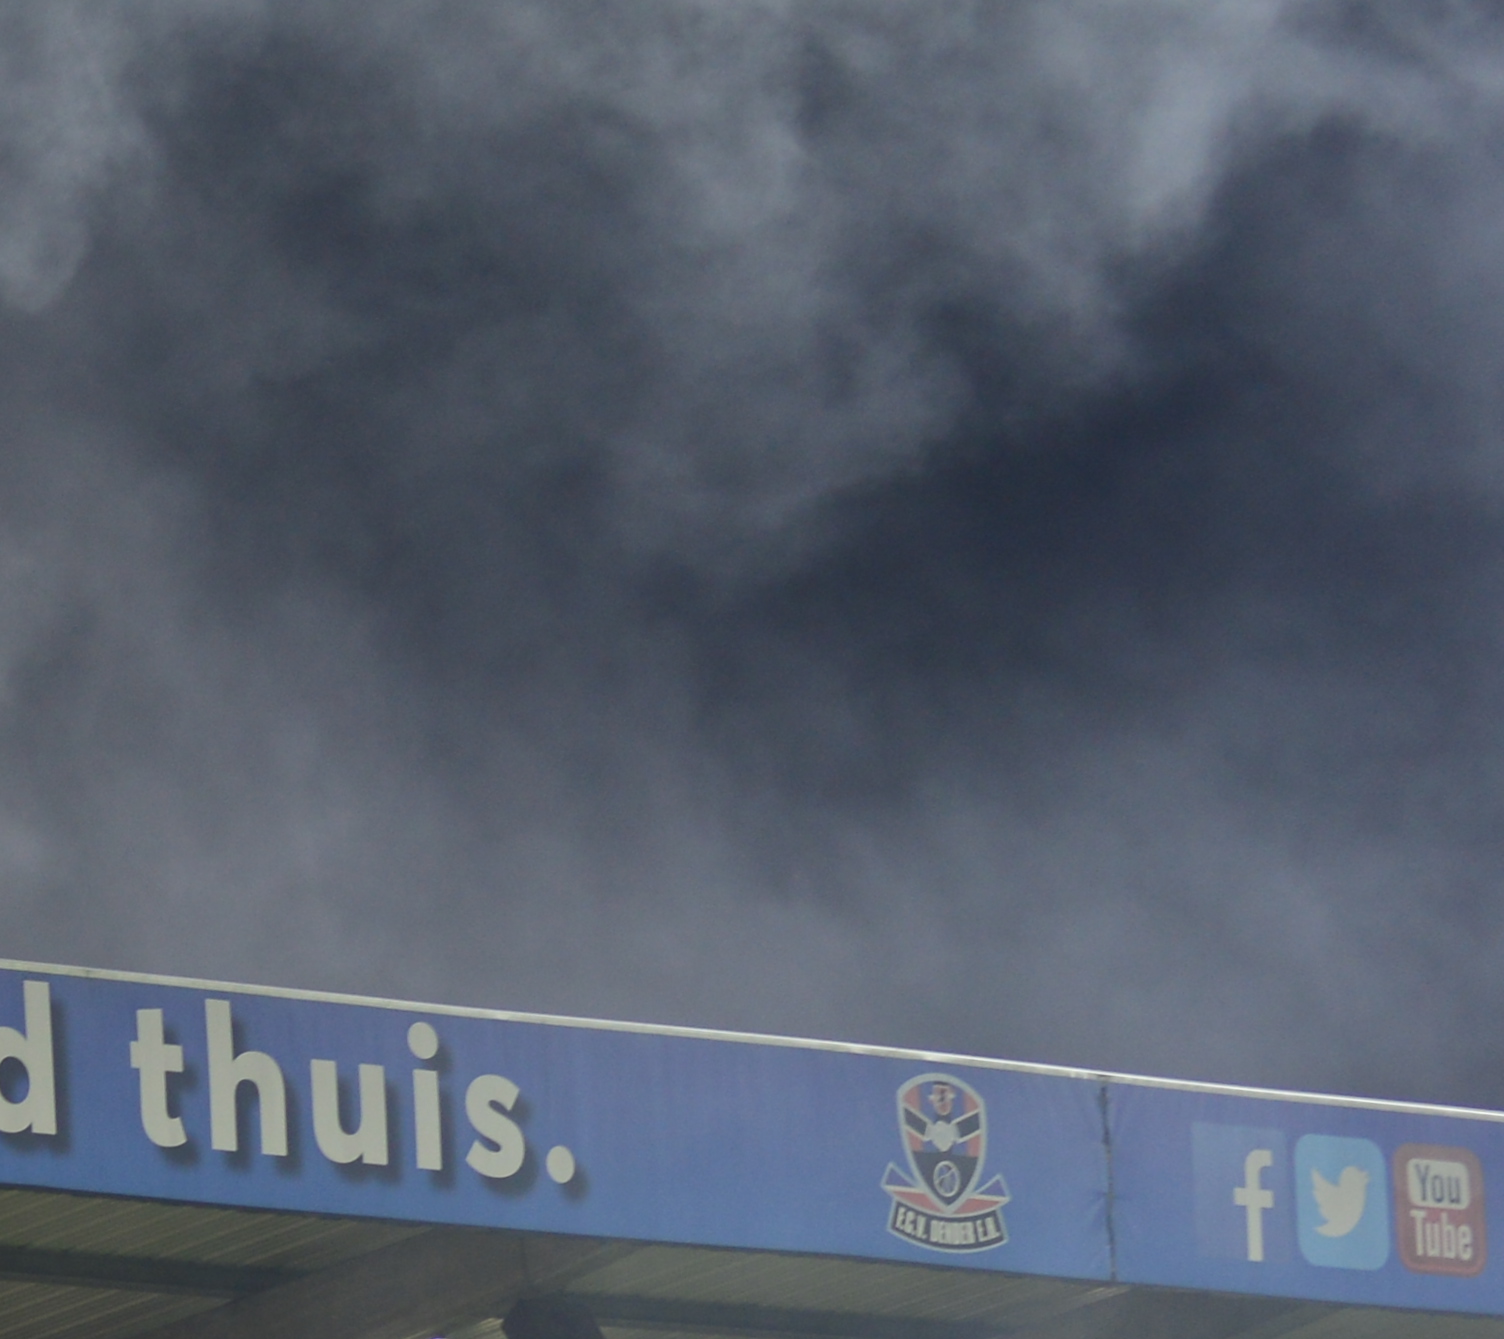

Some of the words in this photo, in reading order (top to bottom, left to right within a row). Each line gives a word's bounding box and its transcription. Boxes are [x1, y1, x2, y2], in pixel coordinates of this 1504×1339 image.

[128, 998, 576, 1184] thuis.
[1414, 1163, 1462, 1205] You
[1409, 1208, 1474, 1262] Tube
